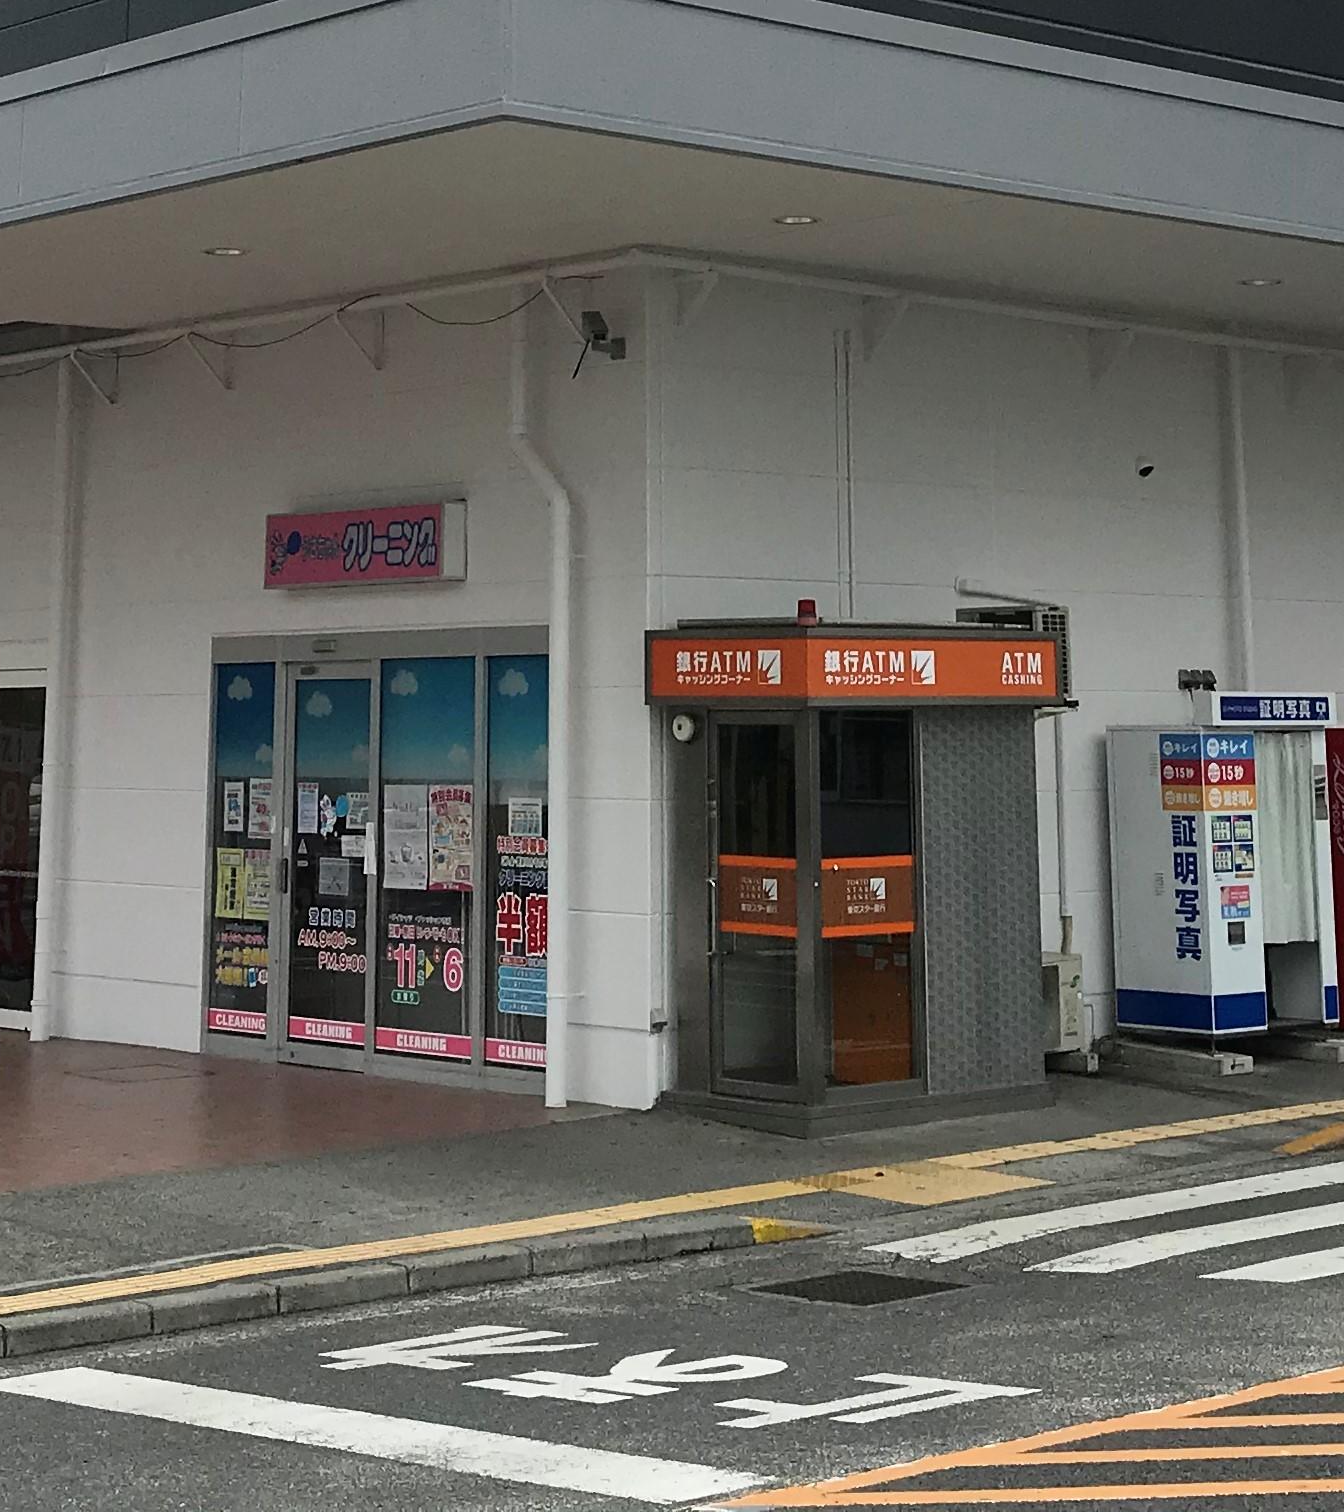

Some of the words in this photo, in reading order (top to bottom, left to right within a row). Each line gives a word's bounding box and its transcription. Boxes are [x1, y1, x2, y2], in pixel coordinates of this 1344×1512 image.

[342, 517, 437, 572] クリーニング
[676, 650, 751, 674] 銀行ATM
[824, 650, 904, 674] 銀行ATM
[1002, 652, 1043, 673] ATM
[676, 674, 751, 686] キャッシングコーナー
[824, 674, 904, 686] キャッシングコーナー
[1002, 674, 1043, 686] CASHING
[1259, 700, 1311, 719] 証明写真
[1173, 742, 1198, 754] キレイ
[1220, 740, 1248, 755] キレイ
[1221, 765, 1244, 781] 15秒
[1171, 814, 1202, 961] 証明写真
[496, 891, 548, 957] 半額
[393, 943, 416, 988] 11
[443, 947, 464, 992] 6
[215, 1014, 266, 1031] CLEANING
[305, 1022, 353, 1040] CLEANING
[396, 1033, 447, 1052] CLEANING
[498, 1044, 547, 1063] CLEANIN
